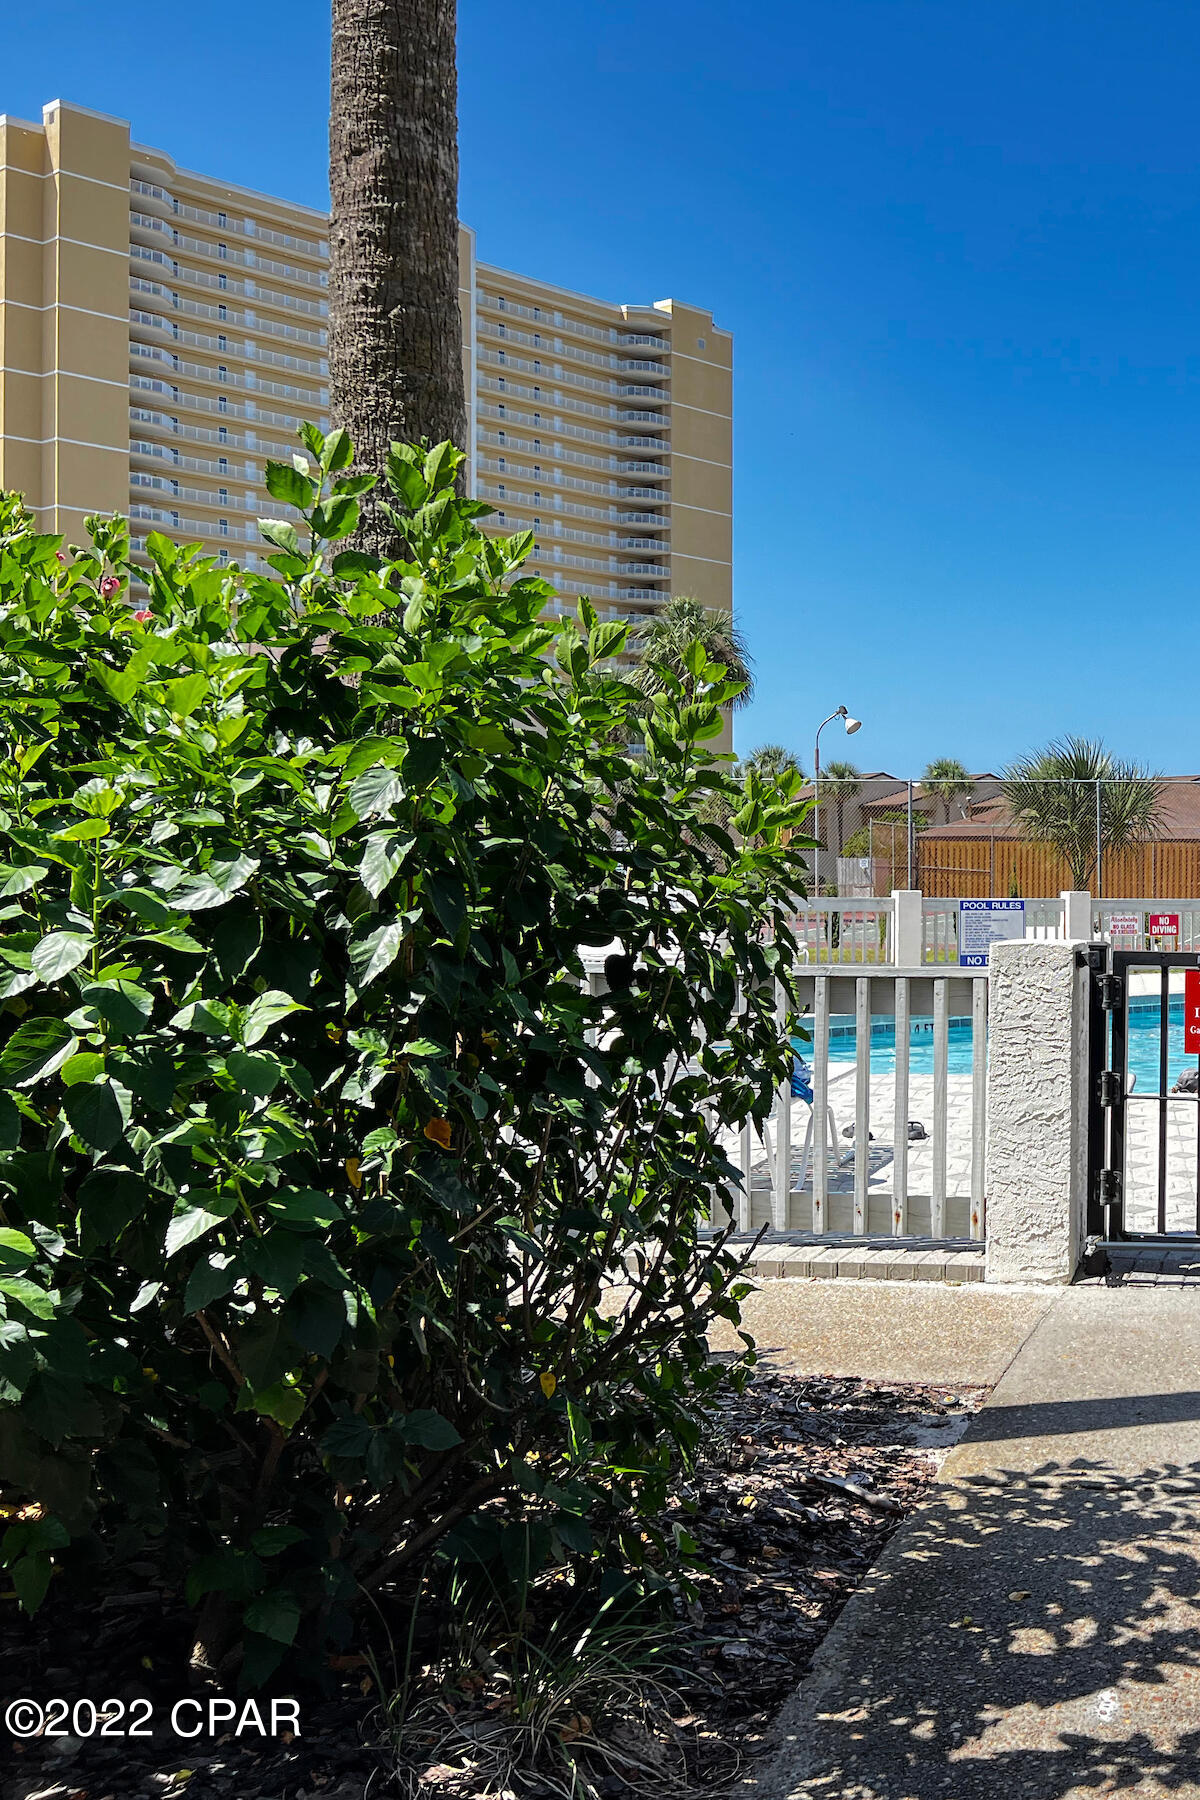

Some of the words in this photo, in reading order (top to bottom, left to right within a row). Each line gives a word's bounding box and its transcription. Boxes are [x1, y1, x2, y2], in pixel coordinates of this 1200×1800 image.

[963, 902, 989, 910] POOL
[992, 902, 1022, 910] RULES
[1159, 916, 1170, 925] NO
[1152, 925, 1177, 934] DIVING
[967, 956, 983, 965] NO
